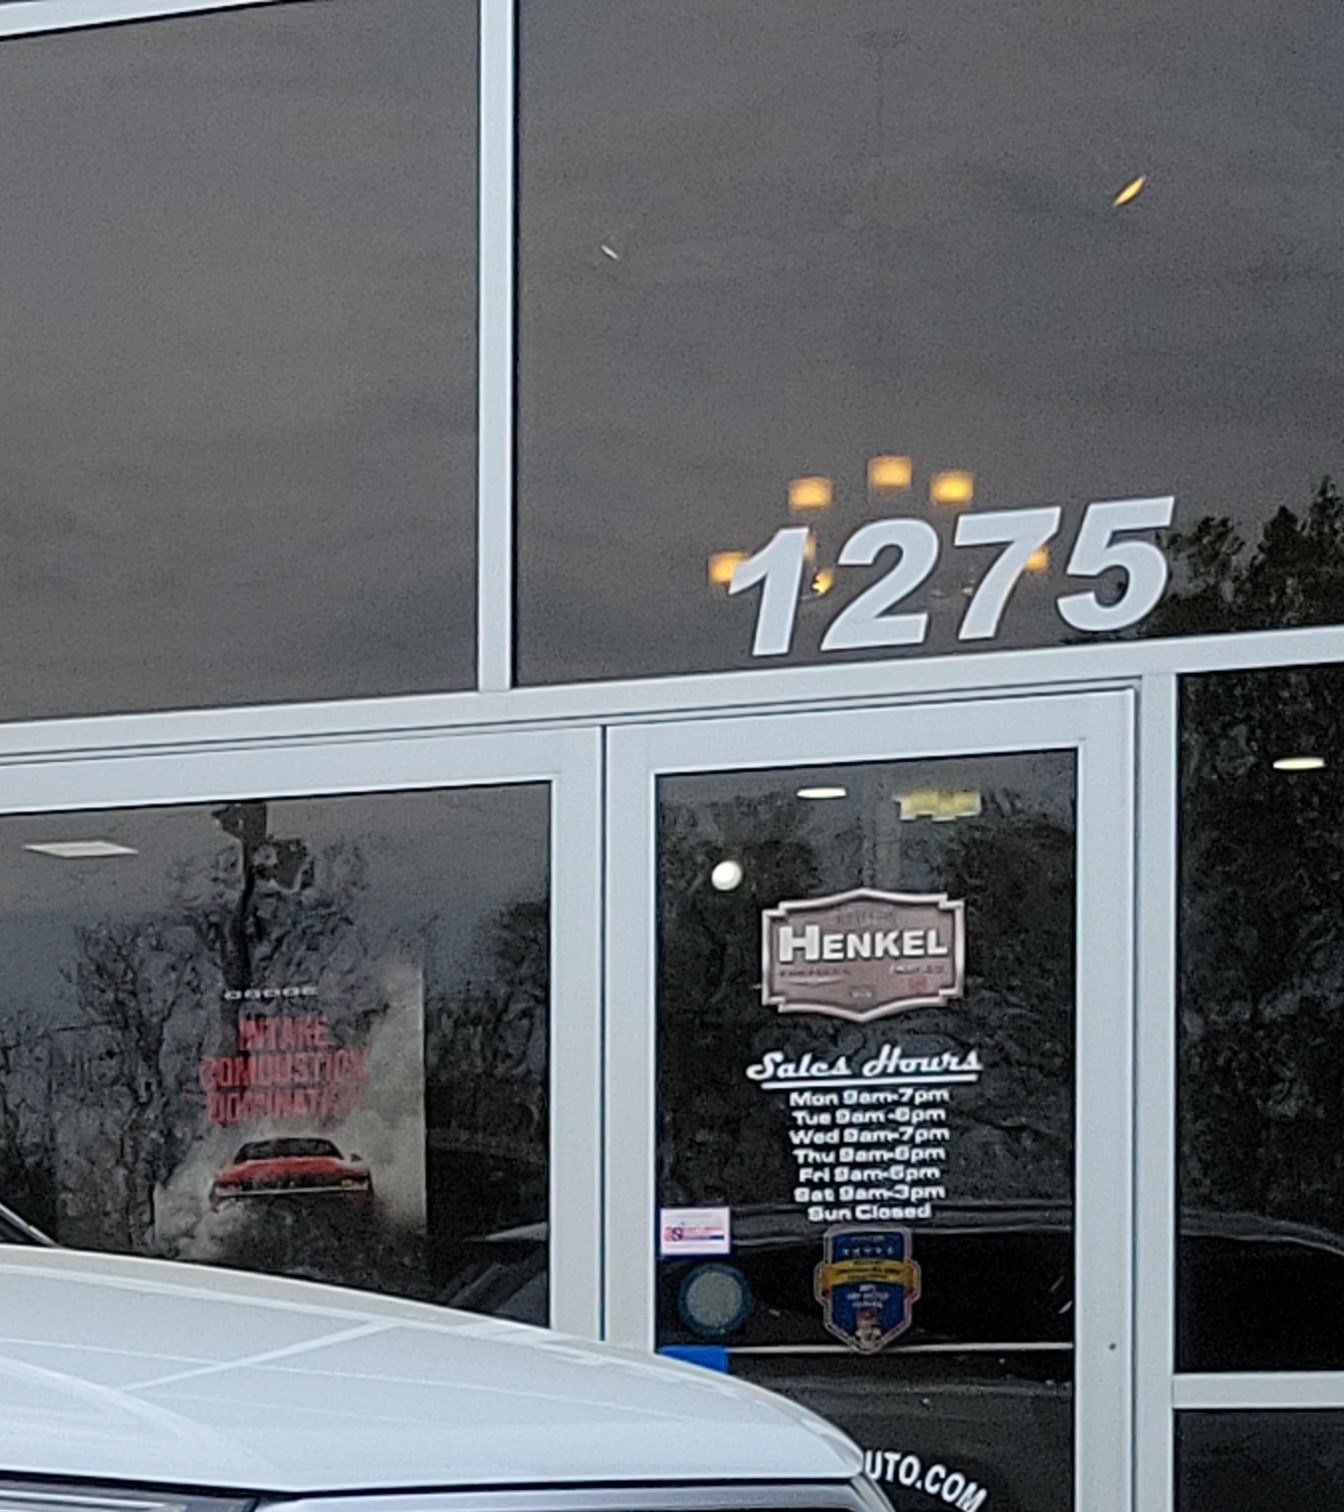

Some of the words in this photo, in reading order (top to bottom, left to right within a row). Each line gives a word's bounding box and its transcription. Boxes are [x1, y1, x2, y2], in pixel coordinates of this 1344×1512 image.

[729, 496, 1175, 656] 1275
[778, 924, 949, 963] HENKEL
[745, 1050, 853, 1080] Sales
[862, 1043, 983, 1077] Hours
[789, 1092, 839, 1107] Mon
[791, 1109, 831, 1126] Tue
[789, 1128, 840, 1145] Wed
[792, 1147, 836, 1164] Thu
[799, 1167, 830, 1182] Fri
[794, 1187, 835, 1202] Sat
[808, 1205, 852, 1222] Sun
[854, 1201, 932, 1220] Closed
